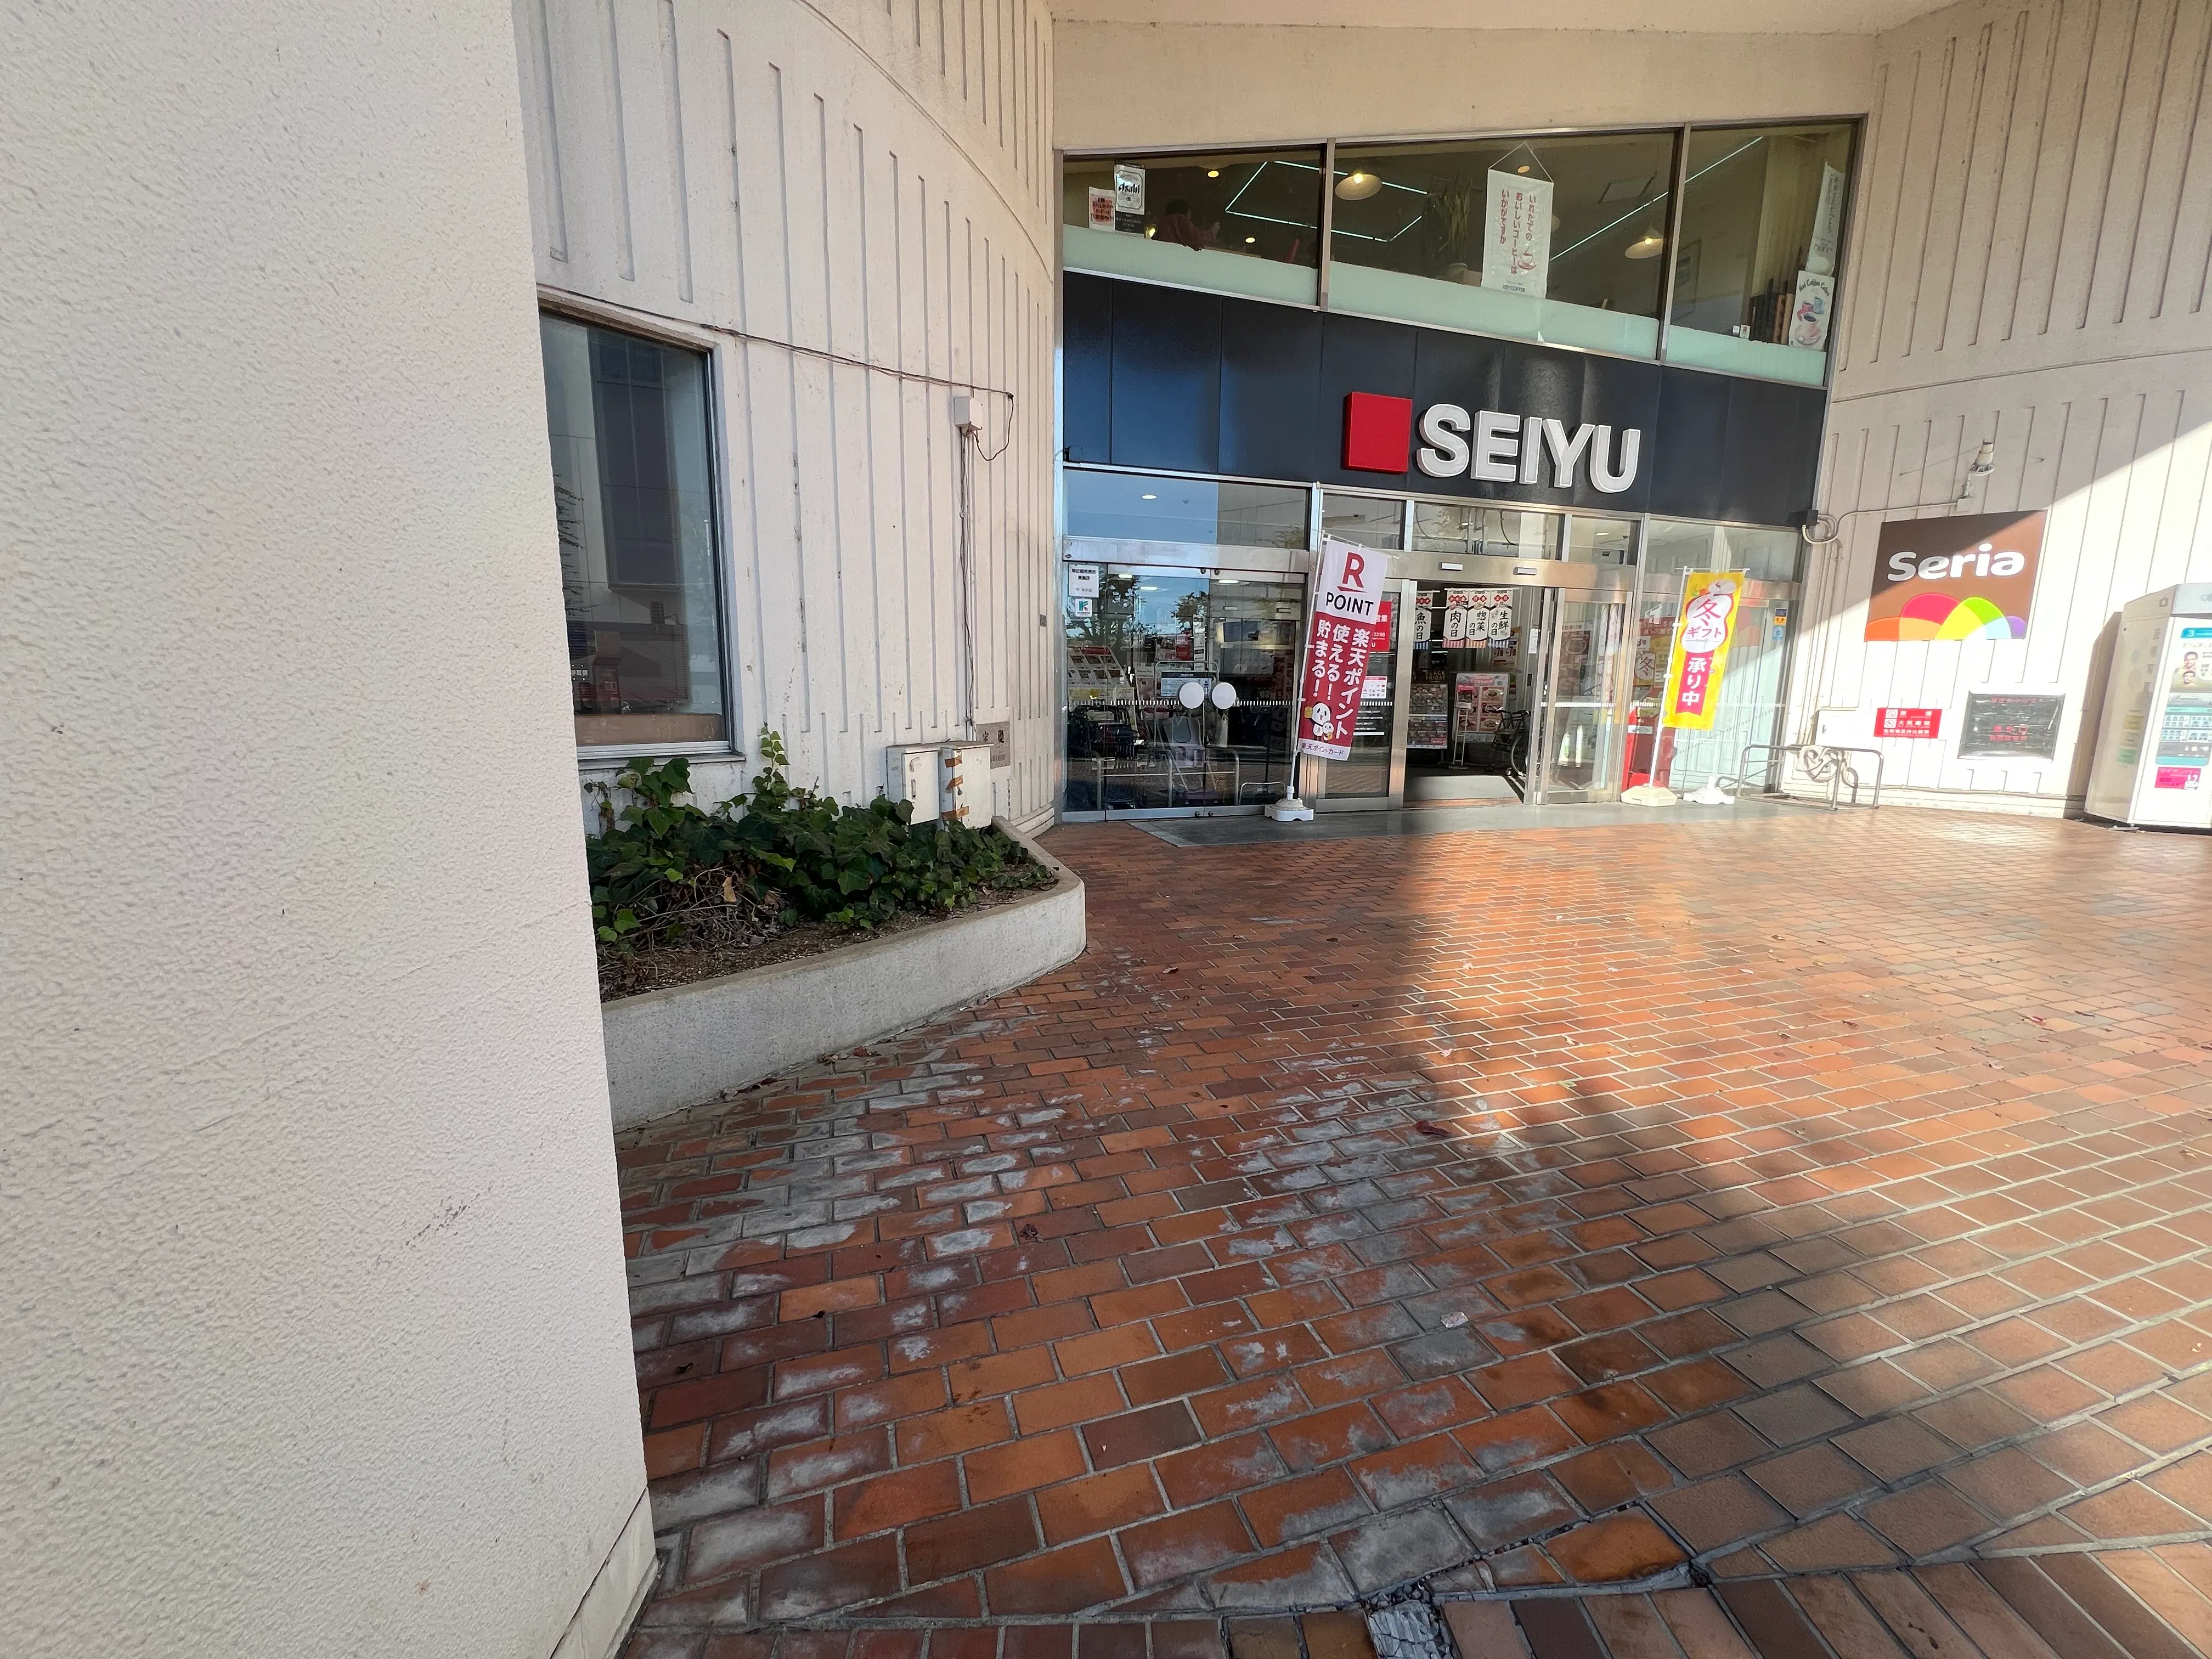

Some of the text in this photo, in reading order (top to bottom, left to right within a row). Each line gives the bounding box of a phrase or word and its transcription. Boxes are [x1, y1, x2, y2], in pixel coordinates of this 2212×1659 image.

[1118, 182, 1140, 194] Asahi
[1500, 189, 1509, 244] いかがですか
[1511, 192, 1523, 274] おいしいコーヒーは
[1417, 403, 1641, 494] SEIYU
[1342, 552, 1365, 589] R
[1887, 542, 2026, 582] Seria
[1326, 591, 1374, 616] POINT
[1693, 599, 1722, 626] 冬
[1415, 612, 1426, 640] 魚の日
[1450, 611, 1462, 637] 肉の日
[1498, 611, 1509, 630] 生鮮
[1687, 626, 1722, 639] ギフト
[1312, 619, 1331, 697] 貯まる！
[1327, 623, 1351, 701] 使える！
[1638, 656, 1655, 676] 冬
[1335, 628, 1371, 740] 楽天ポイント
[1681, 657, 1707, 707] 承り中
[1301, 742, 1344, 756] 楽天ポイントカード
